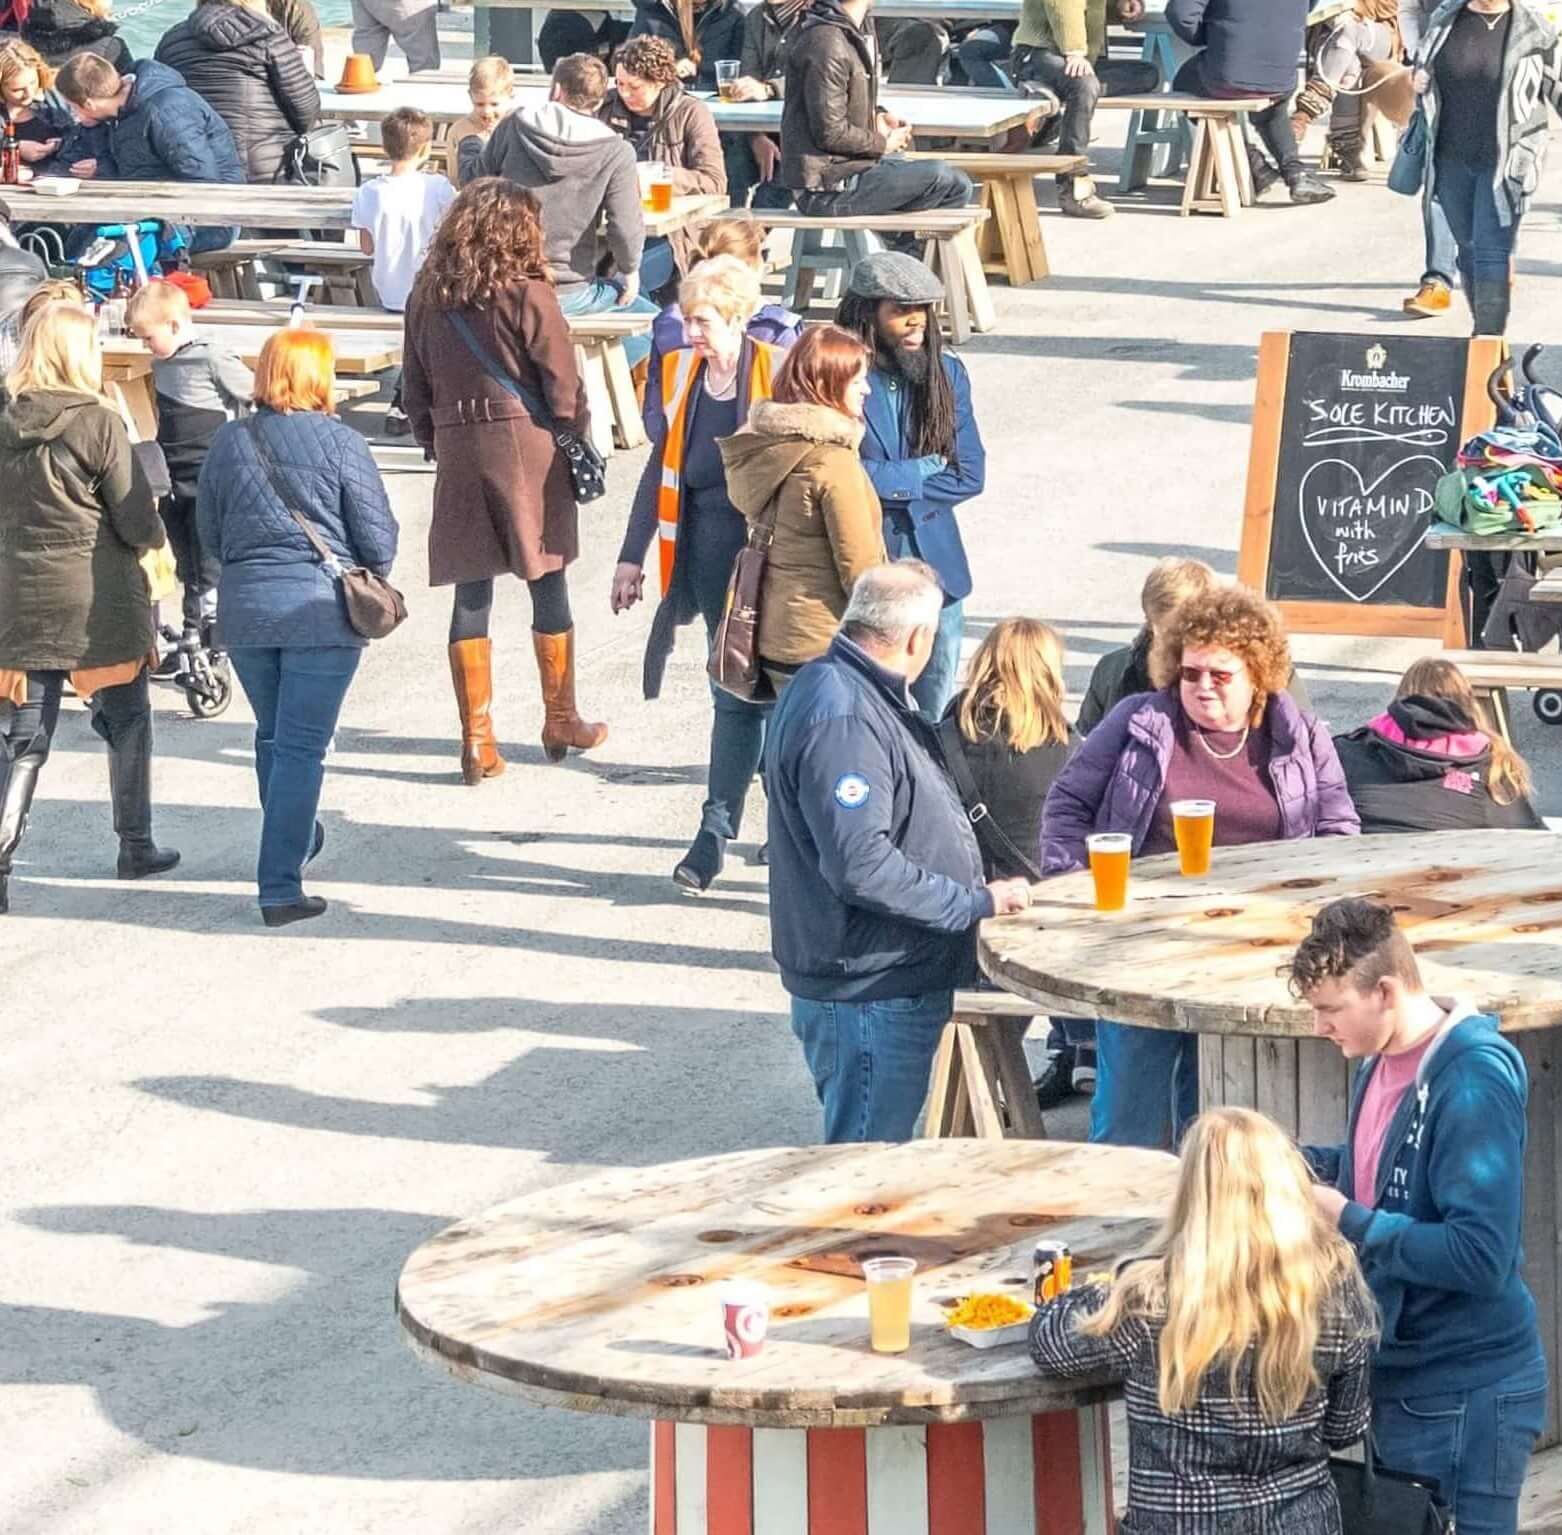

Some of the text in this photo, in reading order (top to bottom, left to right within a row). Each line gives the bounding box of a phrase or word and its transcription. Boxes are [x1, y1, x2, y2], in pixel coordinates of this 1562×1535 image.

[1341, 369, 1411, 389] Krombacher
[1374, 395, 1456, 427] KITCHEN
[1316, 487, 1435, 519] VITAMIN D
[1335, 520, 1376, 540] with
[1334, 542, 1380, 575] fries
